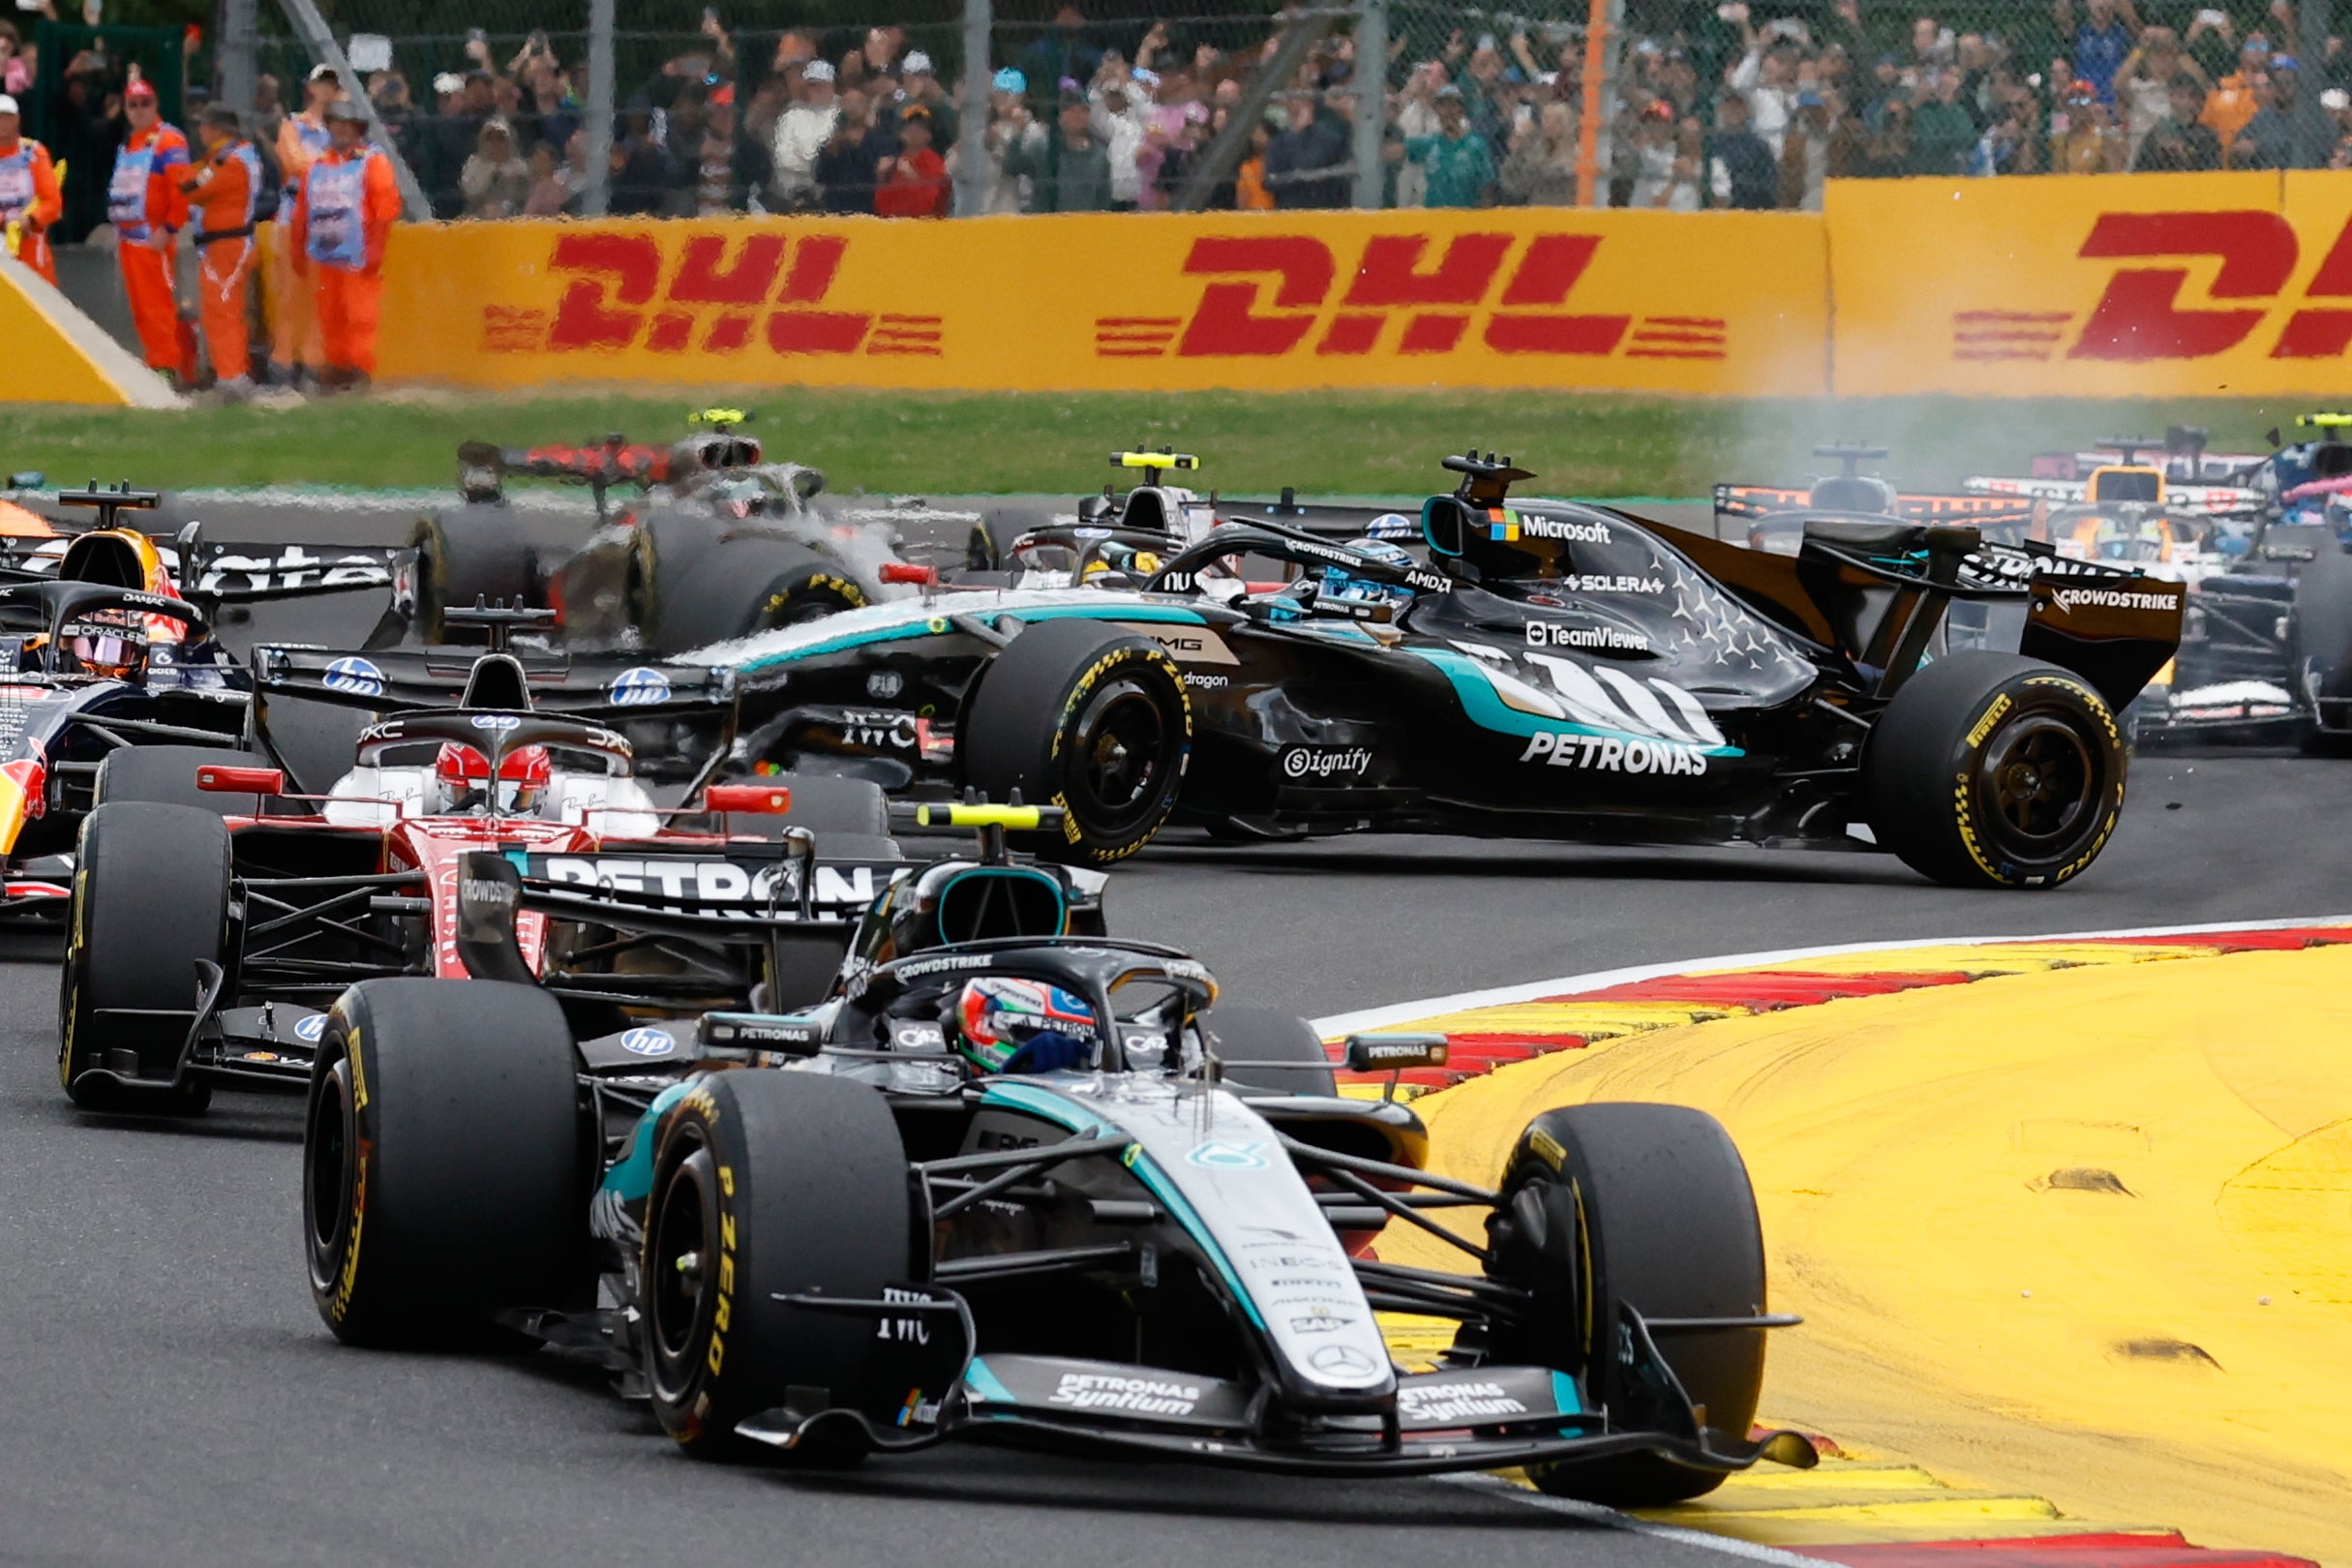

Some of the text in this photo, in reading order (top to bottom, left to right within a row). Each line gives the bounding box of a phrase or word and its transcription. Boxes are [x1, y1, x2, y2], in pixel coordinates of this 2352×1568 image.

[546, 233, 870, 354] DHL
[1176, 232, 1631, 356] DHL
[1523, 515, 1612, 545] Microsoft
[1289, 539, 1362, 568] CROWDSTRIKE
[1405, 570, 1445, 591] AMD
[1581, 575, 1653, 594] SOLERA
[123, 592, 166, 607] DAMAC
[1312, 600, 1350, 615] PETRONAS
[2059, 588, 2178, 611] CROWDSTRIKE
[81, 625, 136, 642] ORACLE
[1151, 635, 1202, 650] MG
[1548, 624, 1649, 651] TeamViewer
[1184, 671, 1228, 689] dragon
[1520, 731, 1706, 775] PETRONAS
[547, 858, 913, 921] PETRON
[898, 953, 994, 979] CROWDSTRIKE
[628, 1028, 669, 1054] hp
[739, 1028, 810, 1042] PETRONAS
[1368, 1045, 1428, 1059] PETRONAS
[708, 1212, 737, 1376] ZERO
[1060, 1373, 1200, 1401] PETRONAS
[1398, 1382, 1506, 1402] ETRONAS
[1048, 1386, 1195, 1416] Syntium
[1400, 1398, 1527, 1422] Syntium
